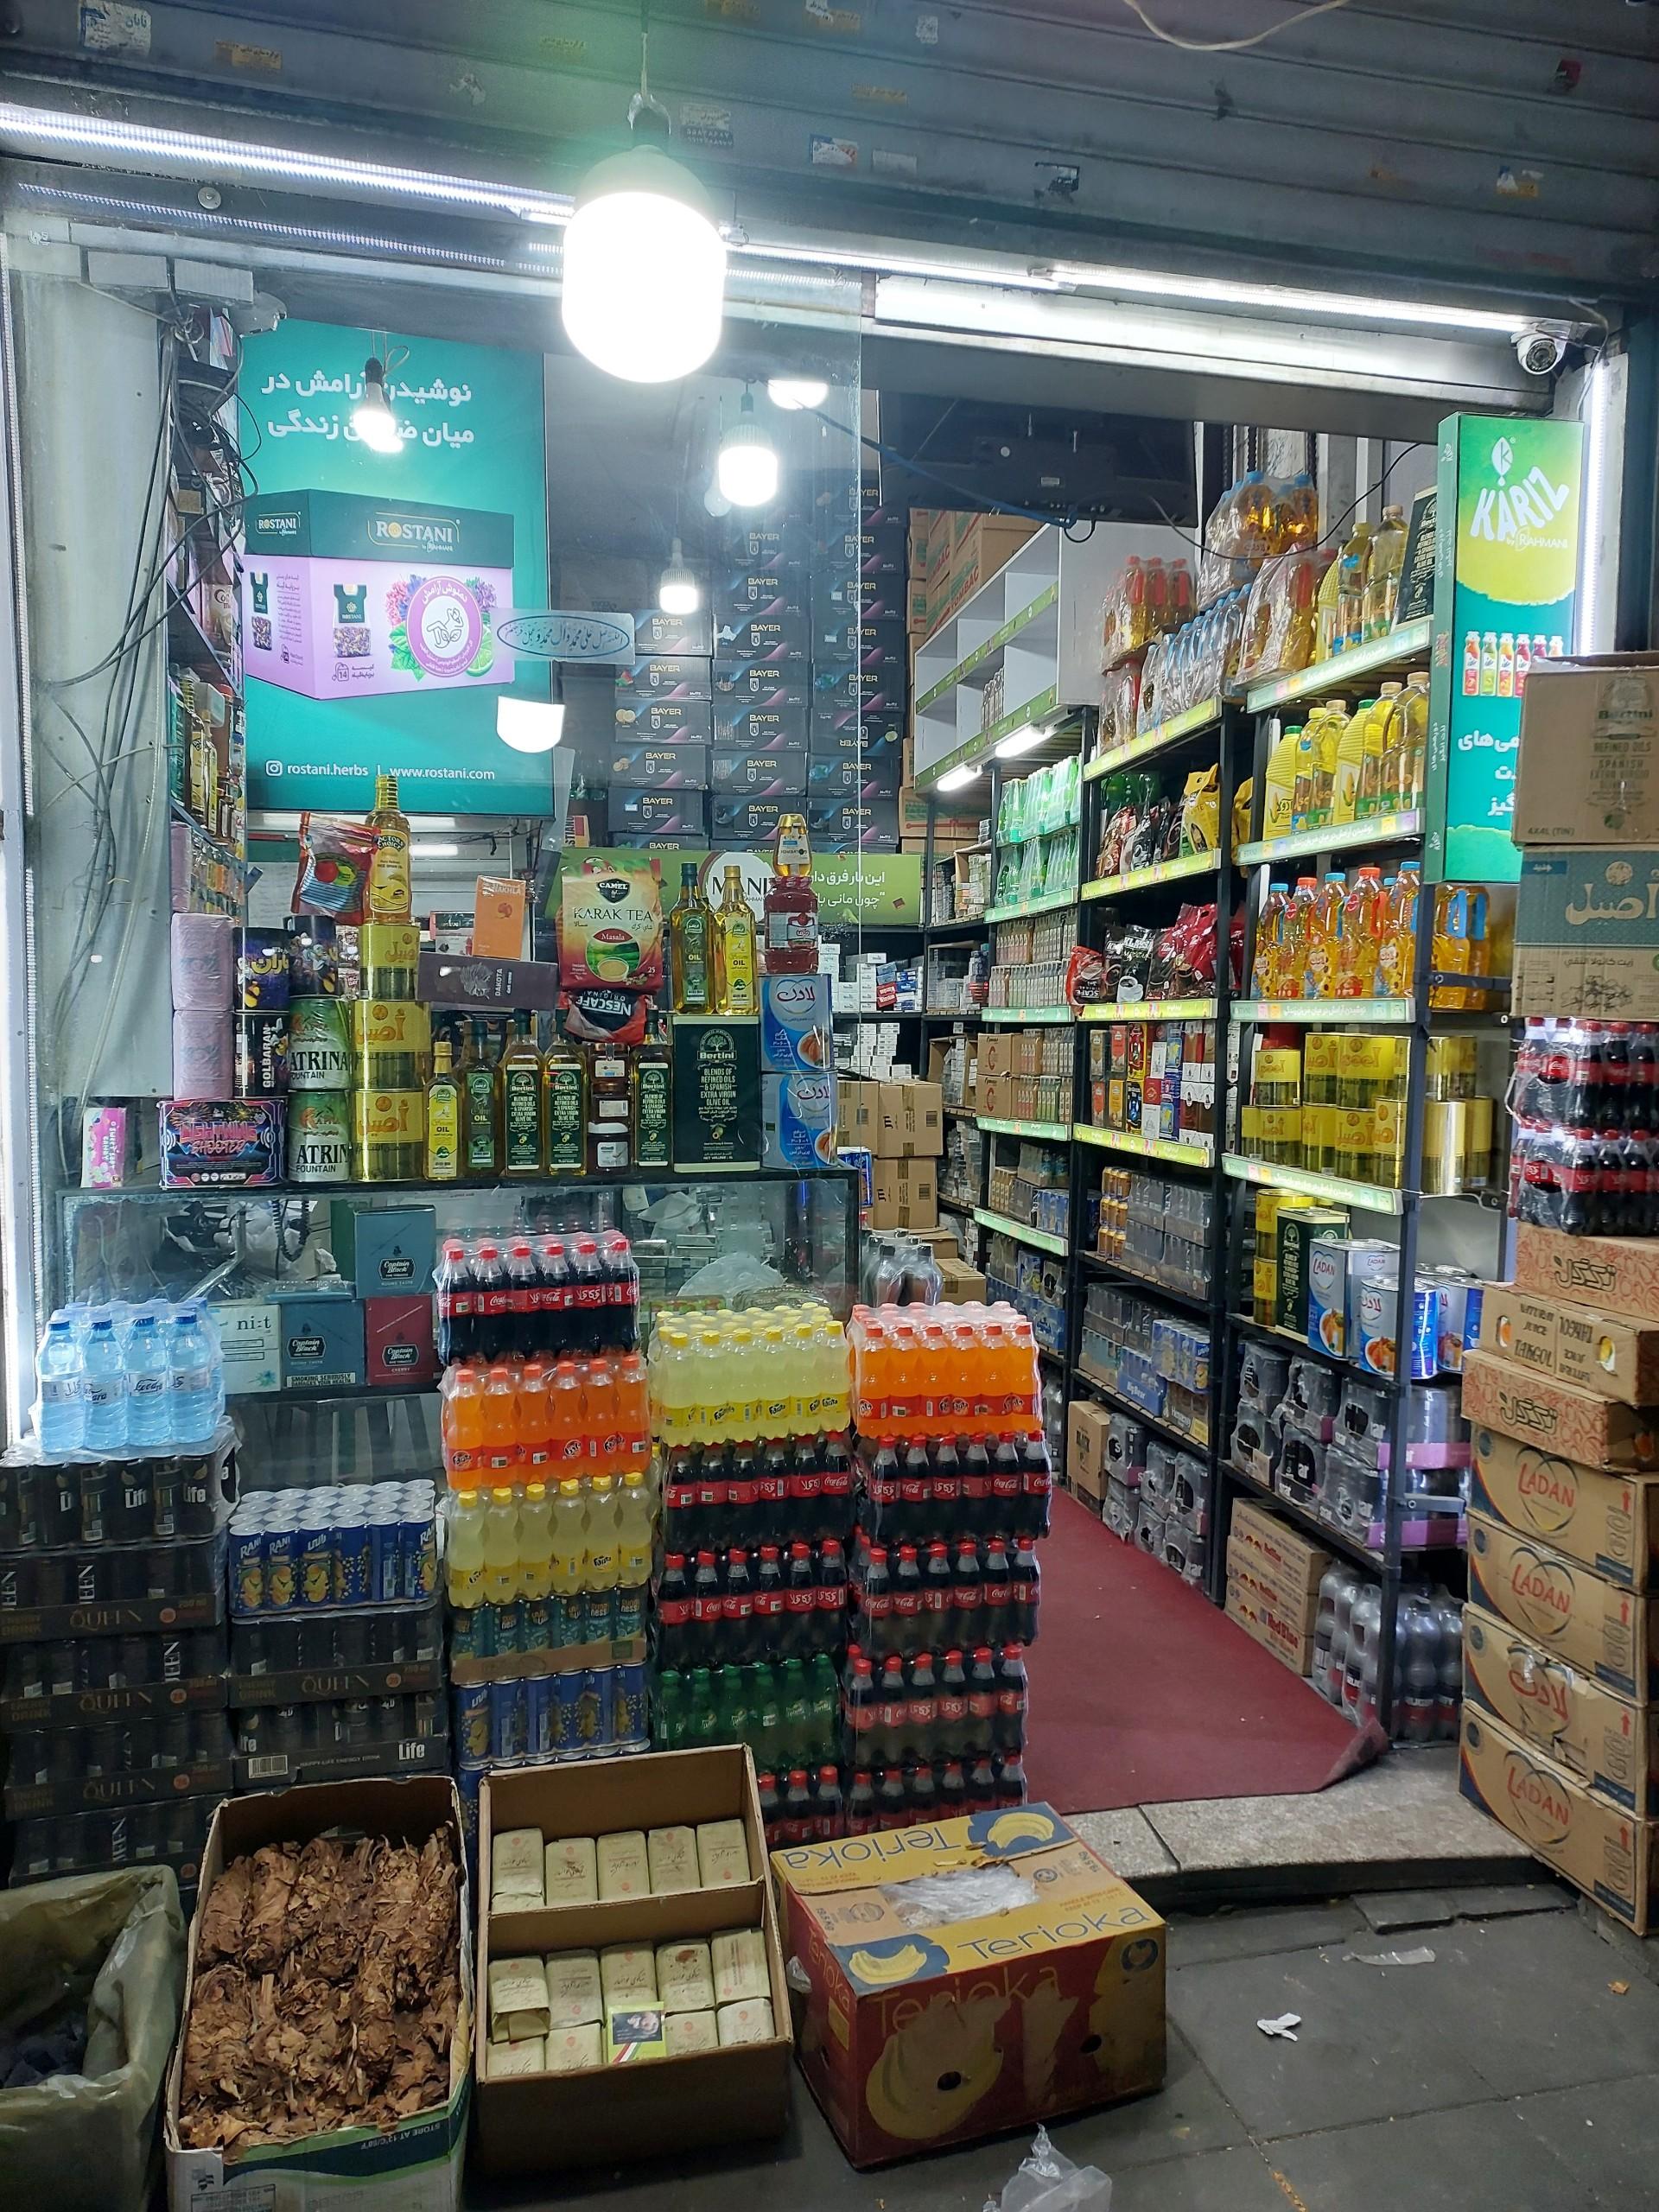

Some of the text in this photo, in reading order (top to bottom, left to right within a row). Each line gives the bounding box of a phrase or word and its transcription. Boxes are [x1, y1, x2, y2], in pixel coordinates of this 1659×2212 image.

[261, 372, 290, 394] در
[267, 409, 339, 441] زندگی
[422, 422, 474, 448] میان
[1471, 466, 1569, 541] KARIZ
[375, 520, 452, 543] ROSTANI
[749, 532, 779, 542] BAYER
[845, 535, 874, 543] BAYER
[748, 577, 778, 586] BAYER
[652, 618, 683, 626] BAYER
[650, 664, 680, 672] BAYER
[749, 670, 779, 678] BAYER
[651, 707, 681, 715] BAYER
[1594, 741, 1652, 753] REFINED OILS
[287, 764, 495, 780] rostani.herbs www.rostani.com
[1599, 760, 1644, 769] SPANISH
[642, 797, 672, 805] BAYER
[748, 804, 778, 813] BAYER
[1552, 827, 1575, 836] (TIN)
[827, 871, 849, 886] فرق
[864, 871, 885, 886] این
[828, 893, 853, 907] مانی
[574, 907, 653, 921] KARAK TEA
[494, 968, 503, 996] DAKOTA
[777, 986, 816, 1002] لادن
[263, 1027, 272, 1088] GOLBARAN
[797, 1084, 830, 1100] لادن
[296, 1164, 336, 1173] FOUNTAIN
[384, 1260, 410, 1268] Captain
[1313, 1258, 1335, 1276] LADAN
[291, 1338, 320, 1347] Captain
[1518, 1463, 1575, 1508] LADAN
[1512, 1564, 1570, 1614] LADAN
[398, 1742, 425, 1761] Life
[1507, 1766, 1569, 1826] LADAN
[783, 1827, 961, 1869] Terioka
[957, 1907, 1151, 1960] Terioka
[808, 1929, 852, 2012] Terioka
[400, 2131, 410, 2139] AT
[411, 2123, 441, 2137] STORE
